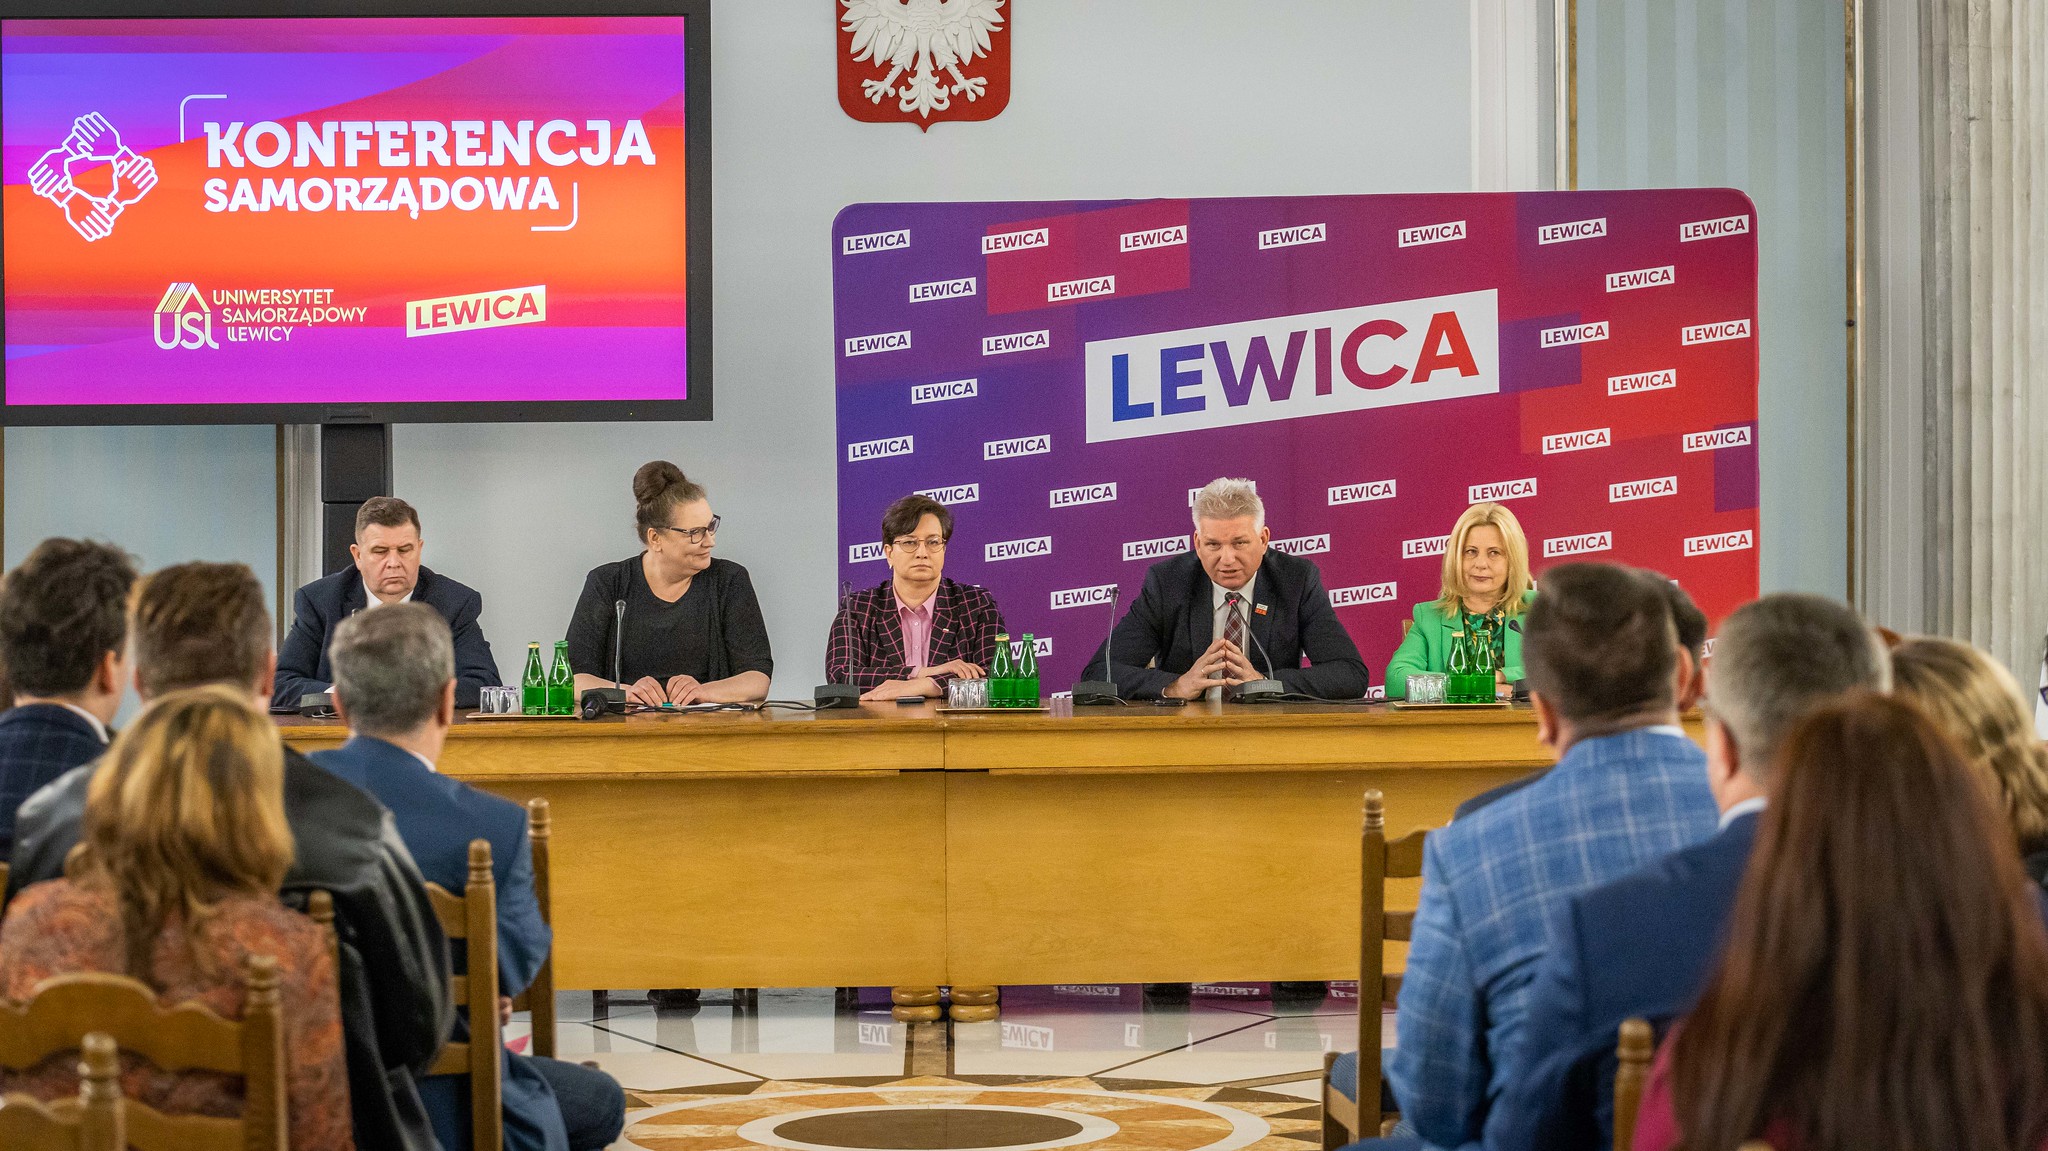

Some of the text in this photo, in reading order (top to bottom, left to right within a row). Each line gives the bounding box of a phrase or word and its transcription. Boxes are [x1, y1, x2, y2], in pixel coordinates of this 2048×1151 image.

[203, 119, 656, 168] KONFERENCJA
[204, 176, 560, 220] SAMORZĄDOWA
[1263, 226, 1323, 247] LEWICA
[1402, 224, 1463, 245] LEWICA
[1542, 221, 1603, 242] LEWICA
[1684, 217, 1746, 239] LEWICA
[847, 232, 907, 252] LEWICA
[985, 231, 1046, 251] LEWICA
[1124, 228, 1184, 249] LEWICA
[1051, 279, 1112, 299] LEWICA
[1610, 269, 1671, 289] LEWICA
[213, 288, 335, 306] UNIWERSYTET
[913, 280, 973, 300] LEWICA
[222, 306, 368, 327] SAMORZĄDOWY
[415, 292, 539, 330] LEWICA
[1545, 324, 1606, 345] LEWICA
[1686, 322, 1747, 343] LEWICA
[849, 333, 908, 354] LEWICA
[986, 333, 1047, 353] LEWICA
[1112, 311, 1479, 422] LEWICA
[915, 381, 975, 401] LEWICA
[1612, 372, 1673, 393] LEWICA
[852, 438, 911, 459] LEWICA
[987, 437, 1047, 457] LEWICA
[1547, 431, 1607, 451] LEWICA
[1687, 429, 1748, 449] LEWICA
[1054, 485, 1114, 505] LEWICA
[1332, 483, 1393, 503] LEWICA
[1473, 481, 1533, 501] LEWICA
[1613, 479, 1674, 499] LEWICA
[989, 539, 1048, 559] LEWICA
[1127, 538, 1187, 558] LEWICA
[1274, 538, 1326, 553] EWICA
[1547, 535, 1609, 554] LEWICA
[1688, 533, 1749, 553] LEWICA
[1333, 585, 1393, 605] LEWICA
